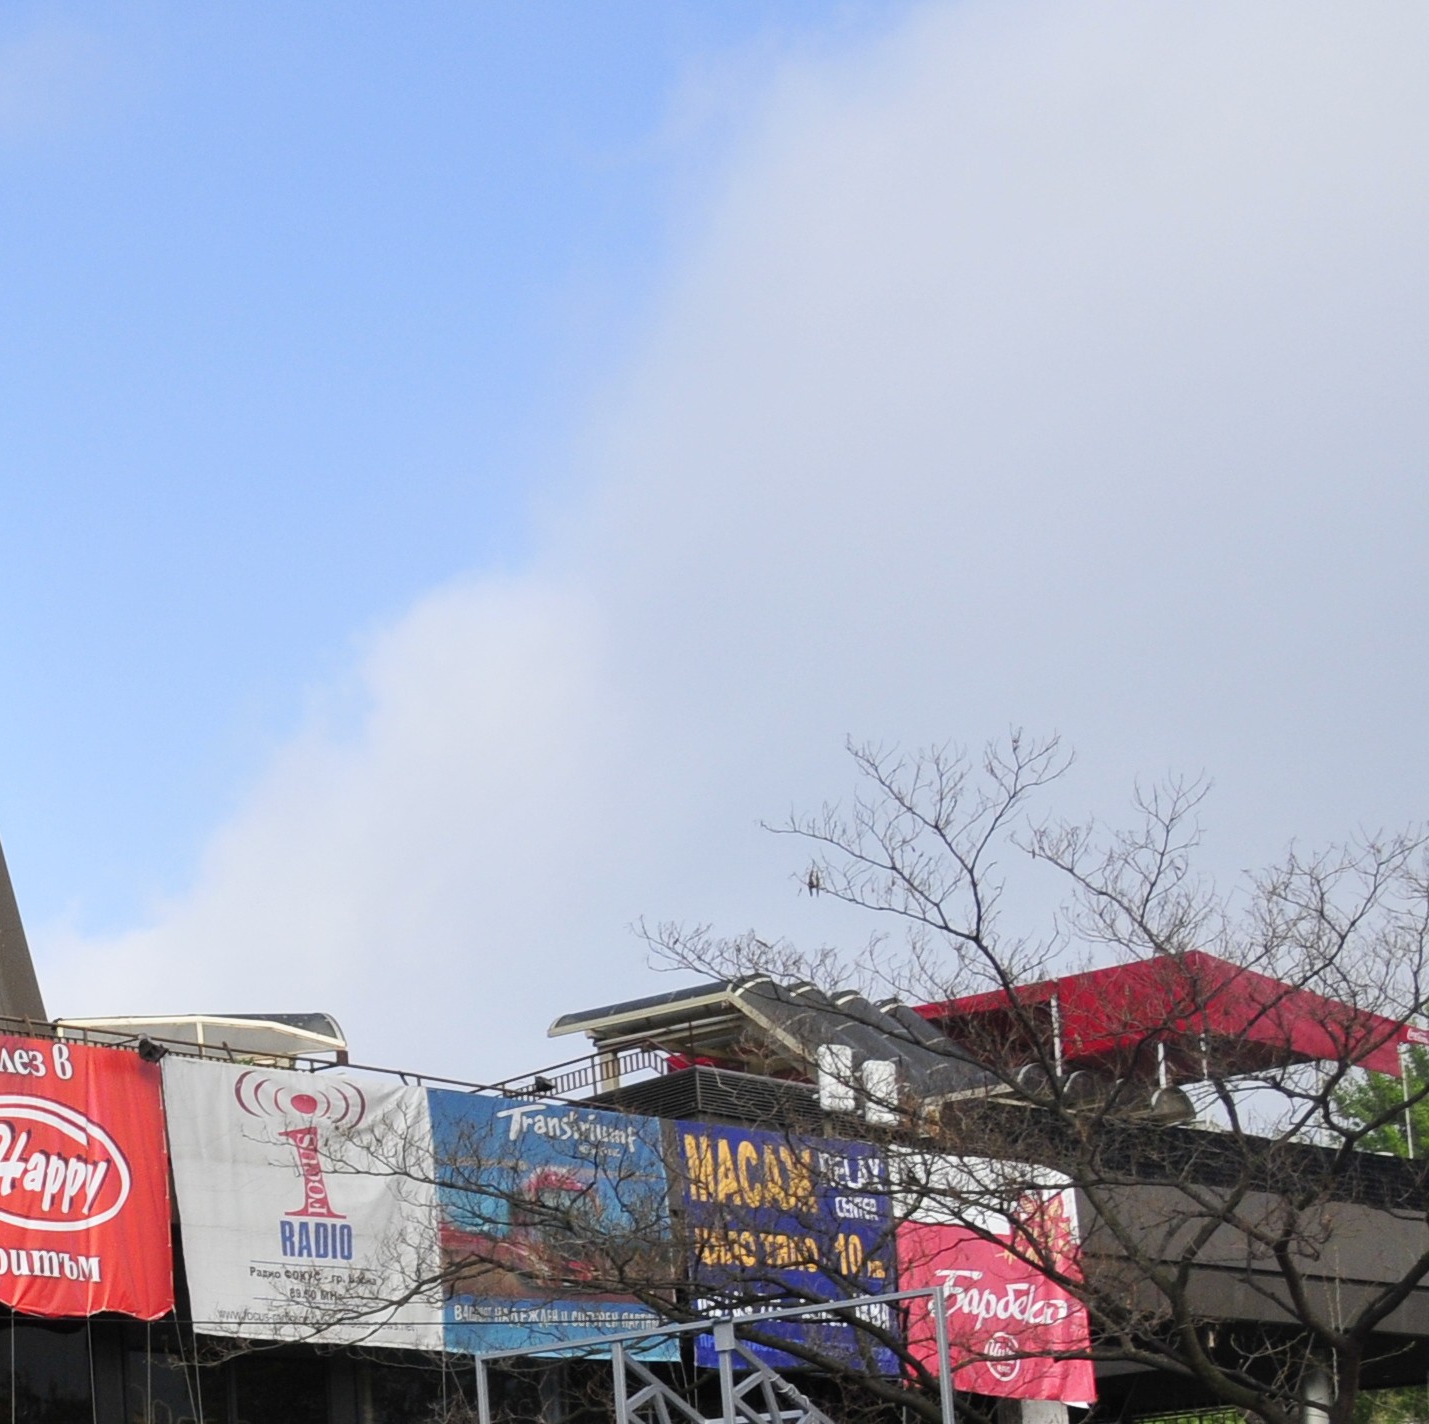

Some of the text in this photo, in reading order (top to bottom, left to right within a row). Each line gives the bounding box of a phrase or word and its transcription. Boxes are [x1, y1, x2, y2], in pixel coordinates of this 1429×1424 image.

[279, 1220, 353, 1260] RADIO
[835, 1233, 864, 1275] 10
[249, 1266, 281, 1279] Радио
